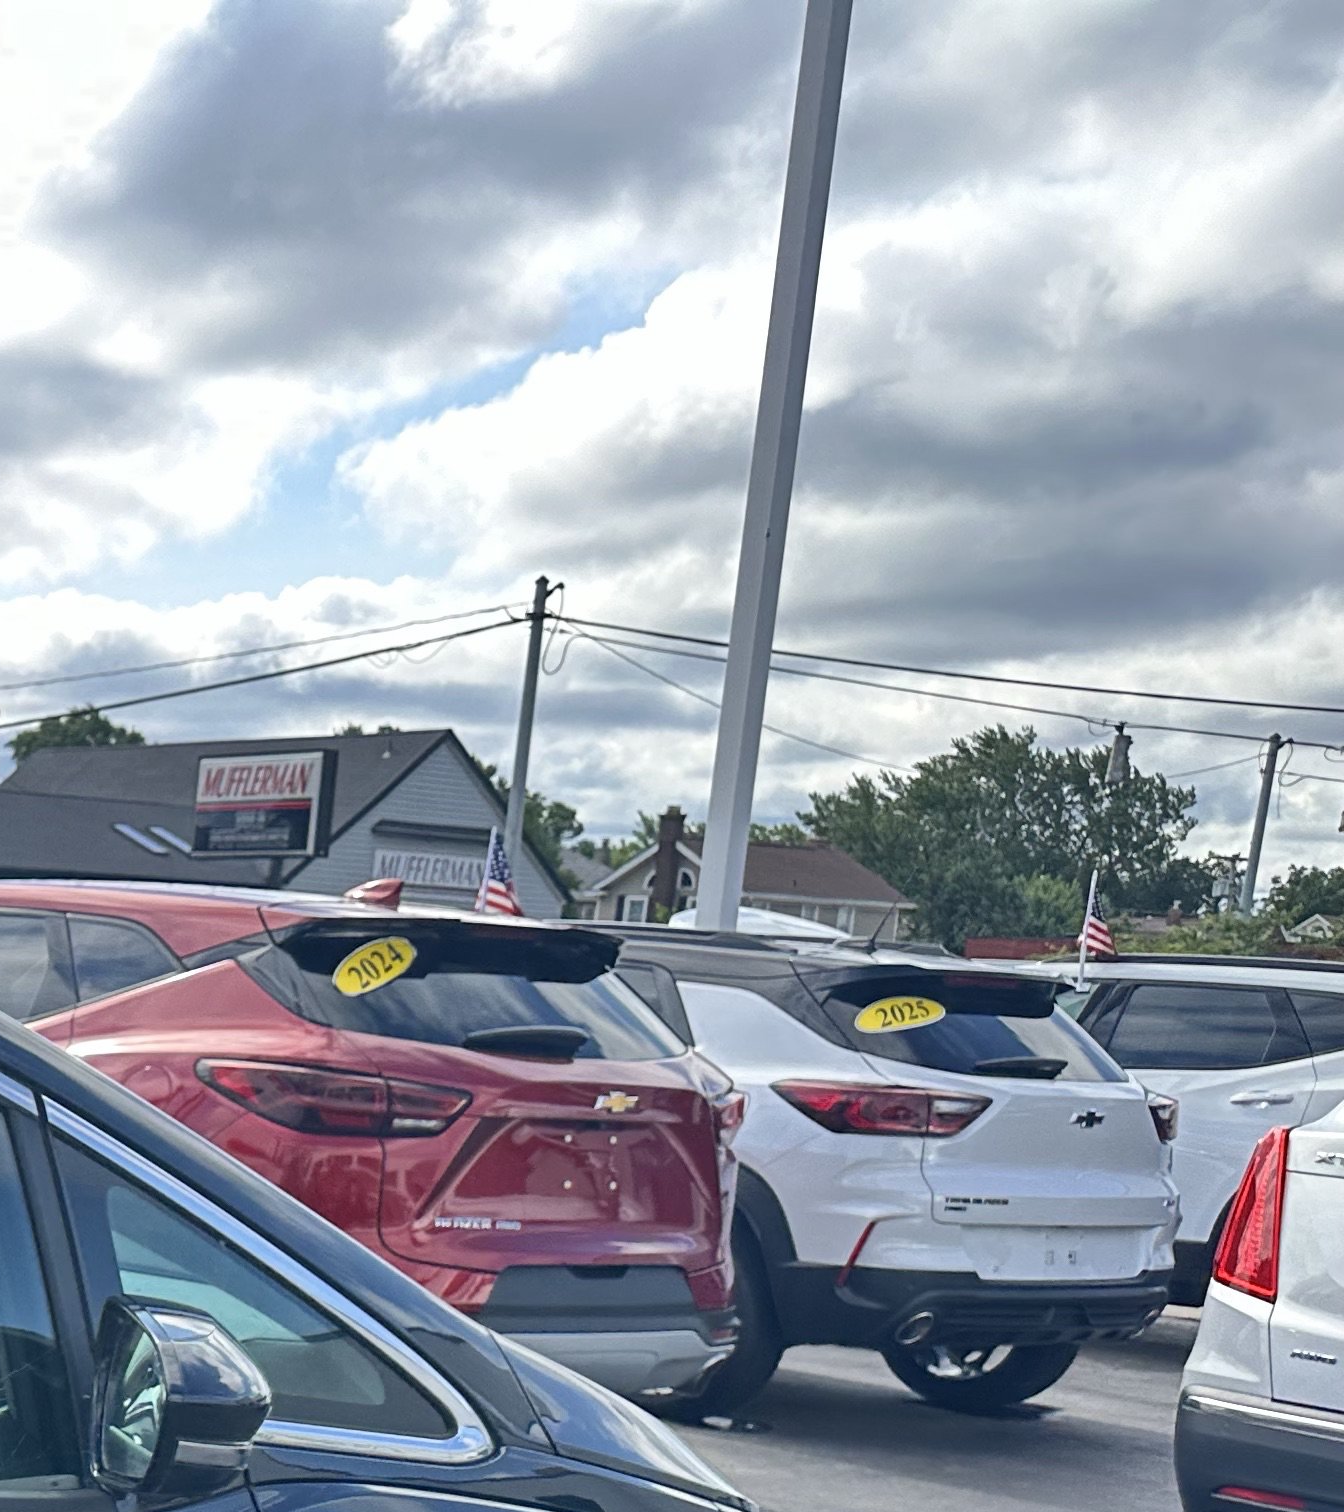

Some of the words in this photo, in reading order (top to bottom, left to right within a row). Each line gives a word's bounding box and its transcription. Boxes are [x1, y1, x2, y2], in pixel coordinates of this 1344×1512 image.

[201, 762, 314, 797] MUFFLERMAN
[348, 943, 404, 989] 2024
[875, 1000, 930, 1028] 2025
